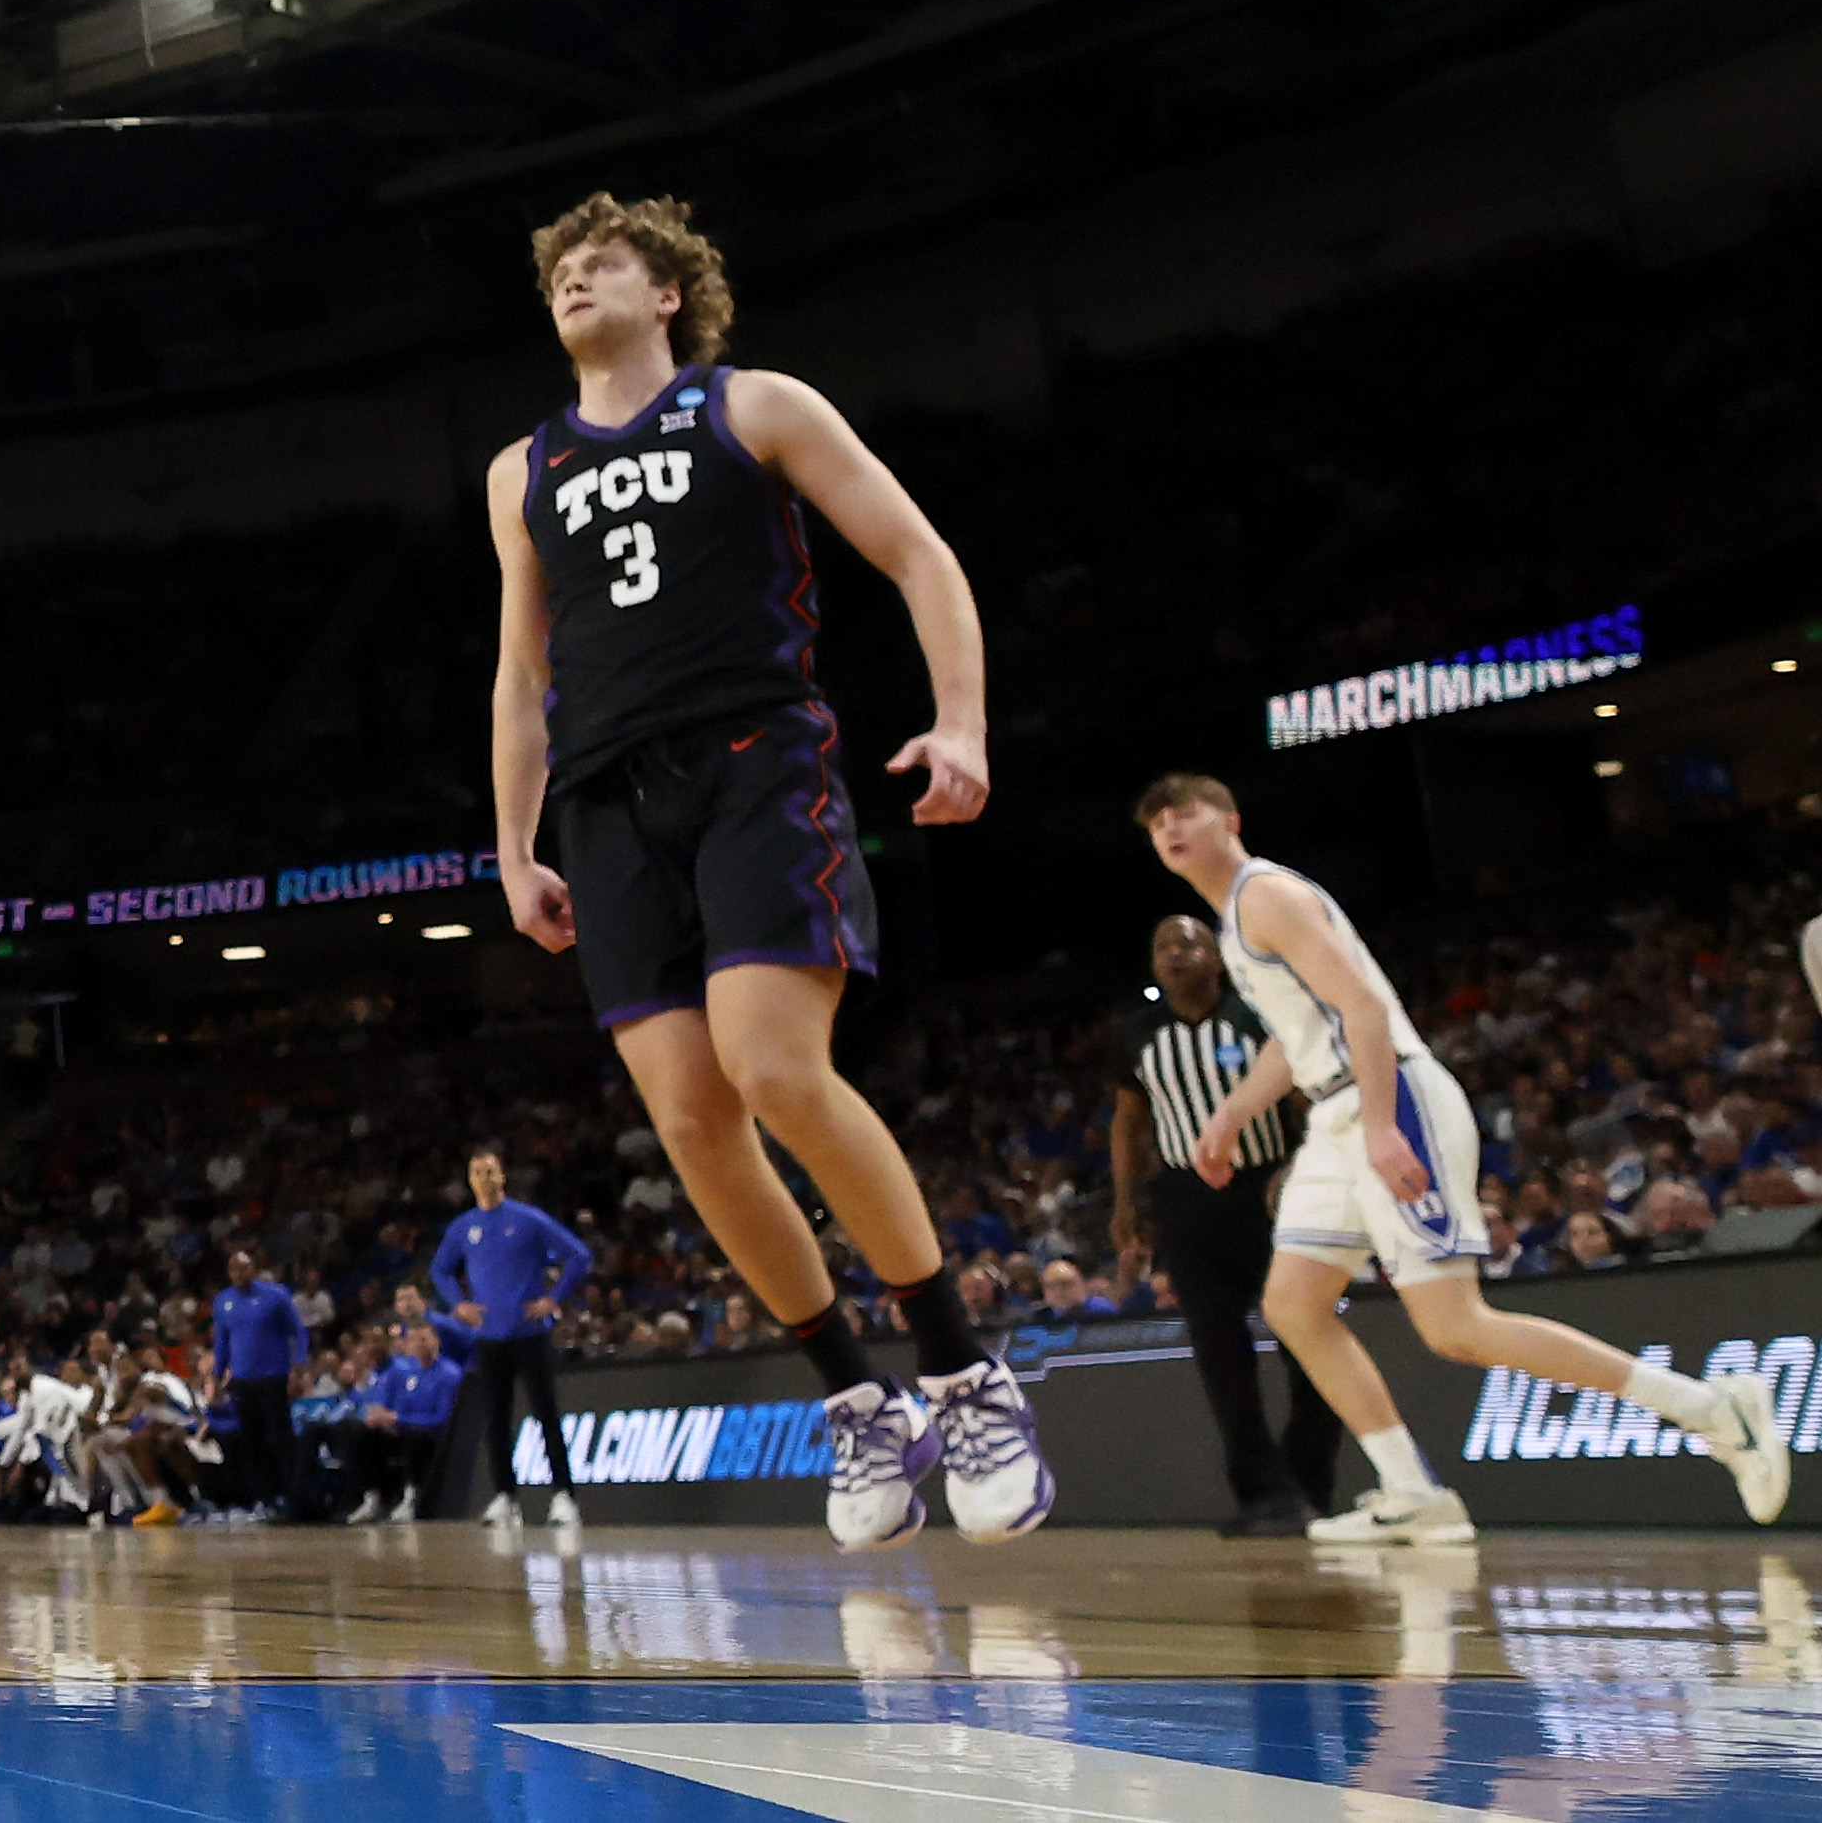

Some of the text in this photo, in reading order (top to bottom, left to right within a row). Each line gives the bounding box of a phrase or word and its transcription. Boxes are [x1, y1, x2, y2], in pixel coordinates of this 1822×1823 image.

[555, 449, 694, 537] TCU
[602, 520, 661, 608] 3
[86, 878, 266, 925] SECOND
[276, 852, 466, 907] ROUNDS
